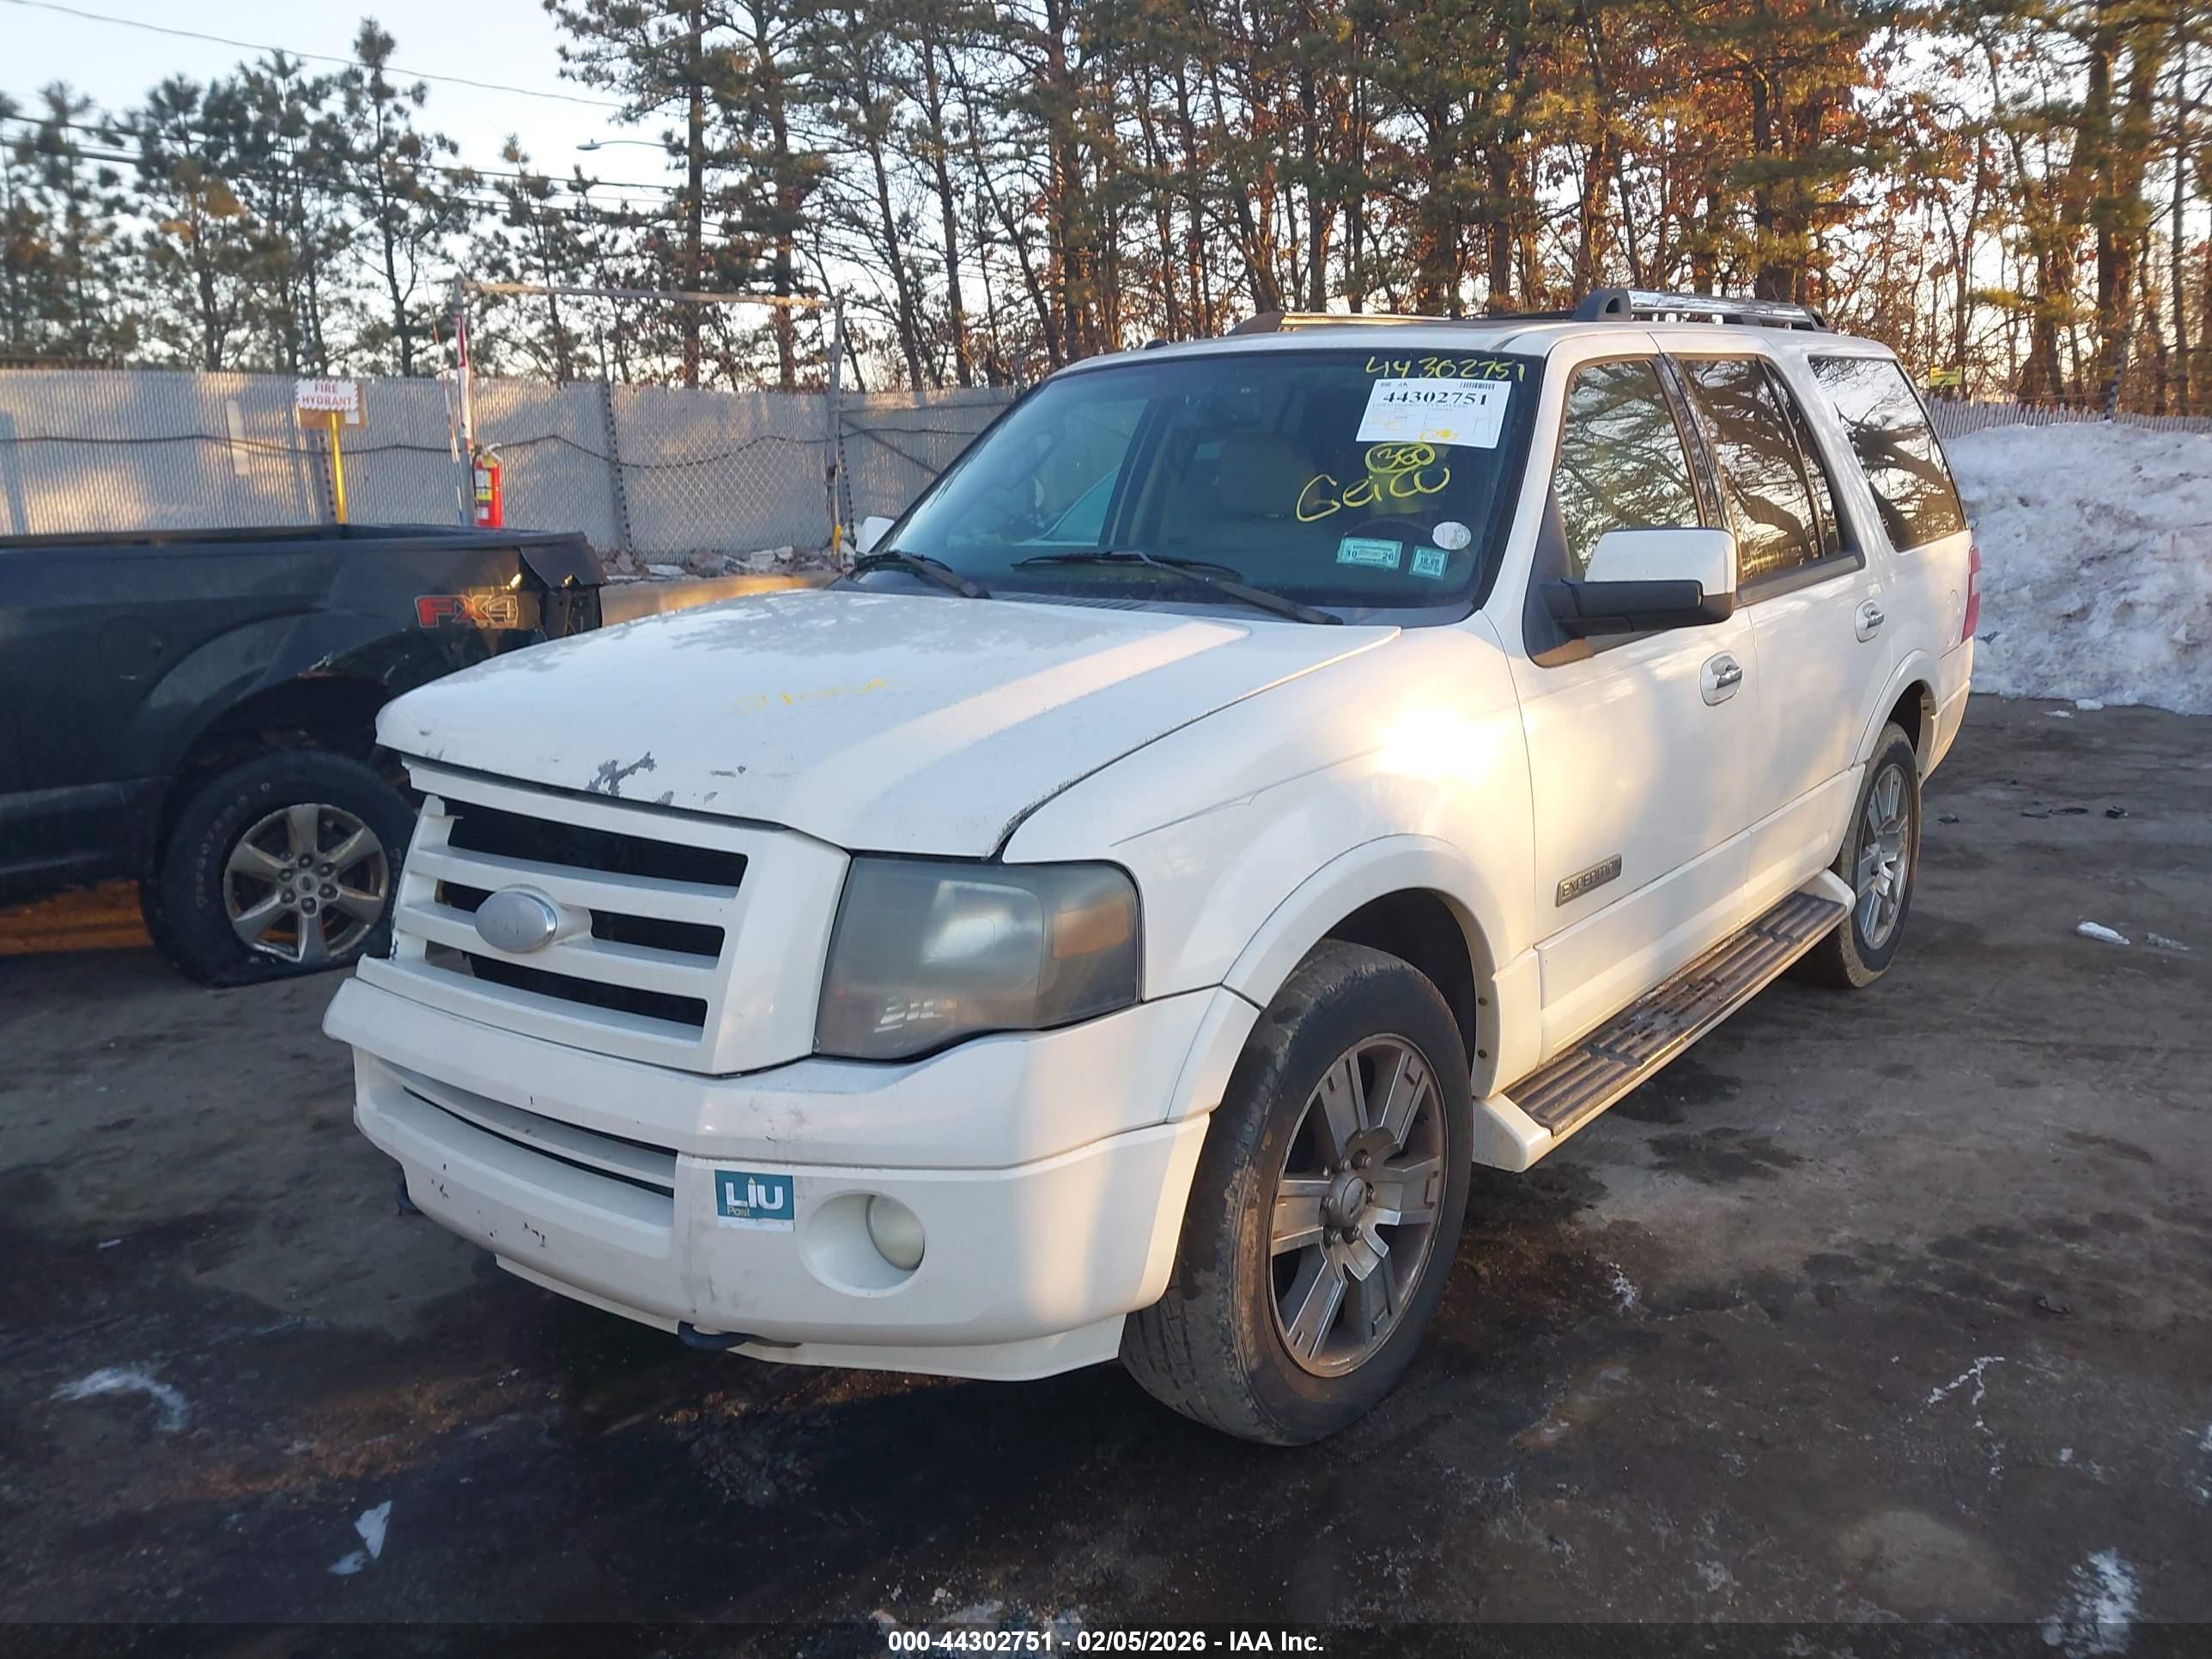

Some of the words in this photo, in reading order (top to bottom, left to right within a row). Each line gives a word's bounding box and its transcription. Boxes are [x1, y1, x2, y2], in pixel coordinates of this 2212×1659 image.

[314, 384, 337, 393] FIRE
[302, 395, 351, 406] HYDRANT
[1382, 391, 1487, 406] 44302751
[415, 594, 519, 628] FX4
[1562, 859, 1620, 897] EXPEDITION
[727, 1204, 750, 1217] Post
